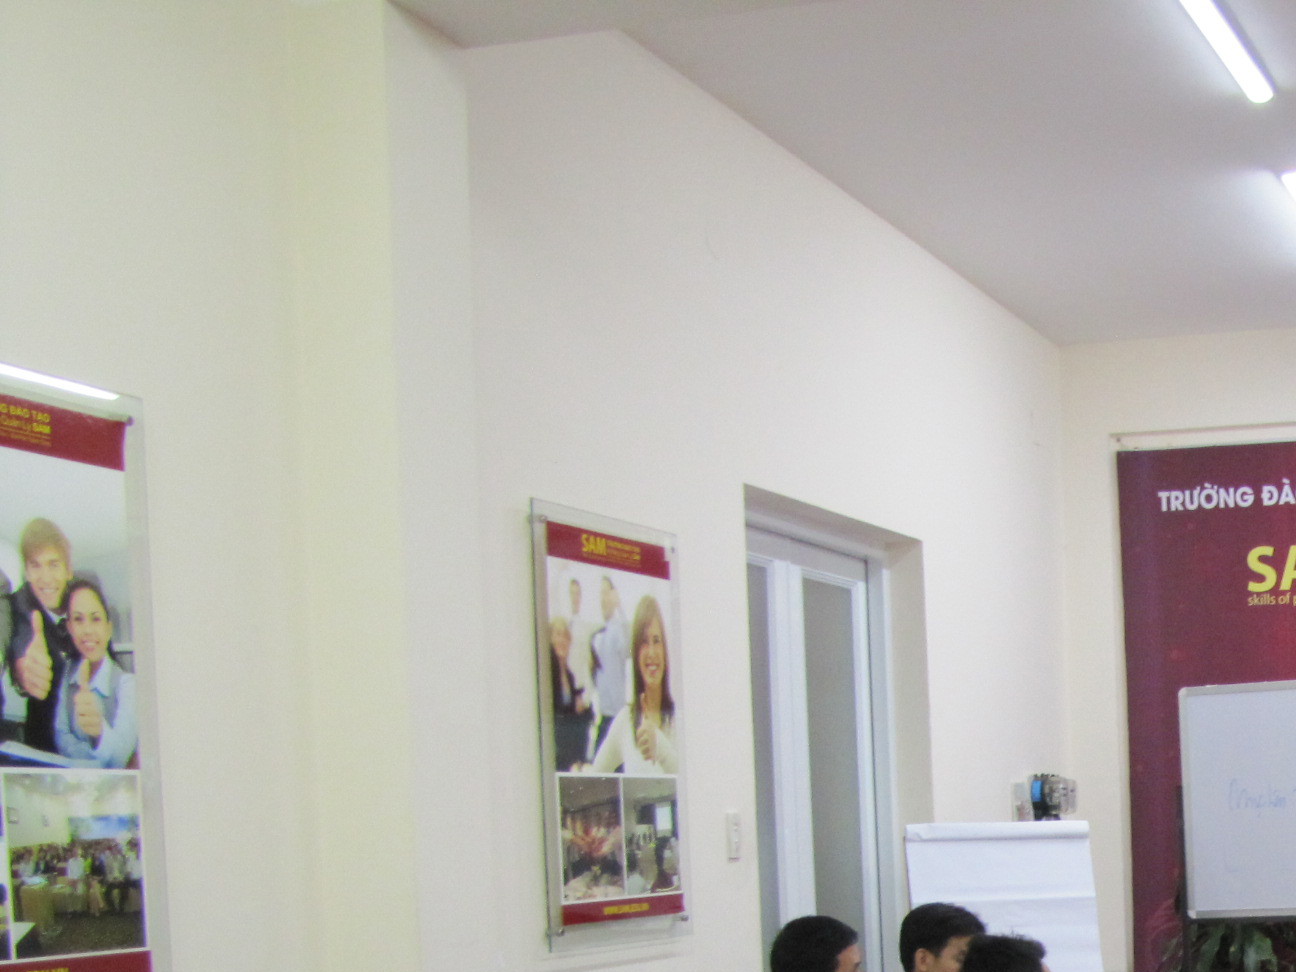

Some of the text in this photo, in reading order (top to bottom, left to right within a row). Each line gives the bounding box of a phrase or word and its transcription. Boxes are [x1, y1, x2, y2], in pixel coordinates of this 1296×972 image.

[1158, 482, 1255, 512] TRƯỜNG
[1248, 593, 1276, 606] skills
[1278, 592, 1291, 605] of
